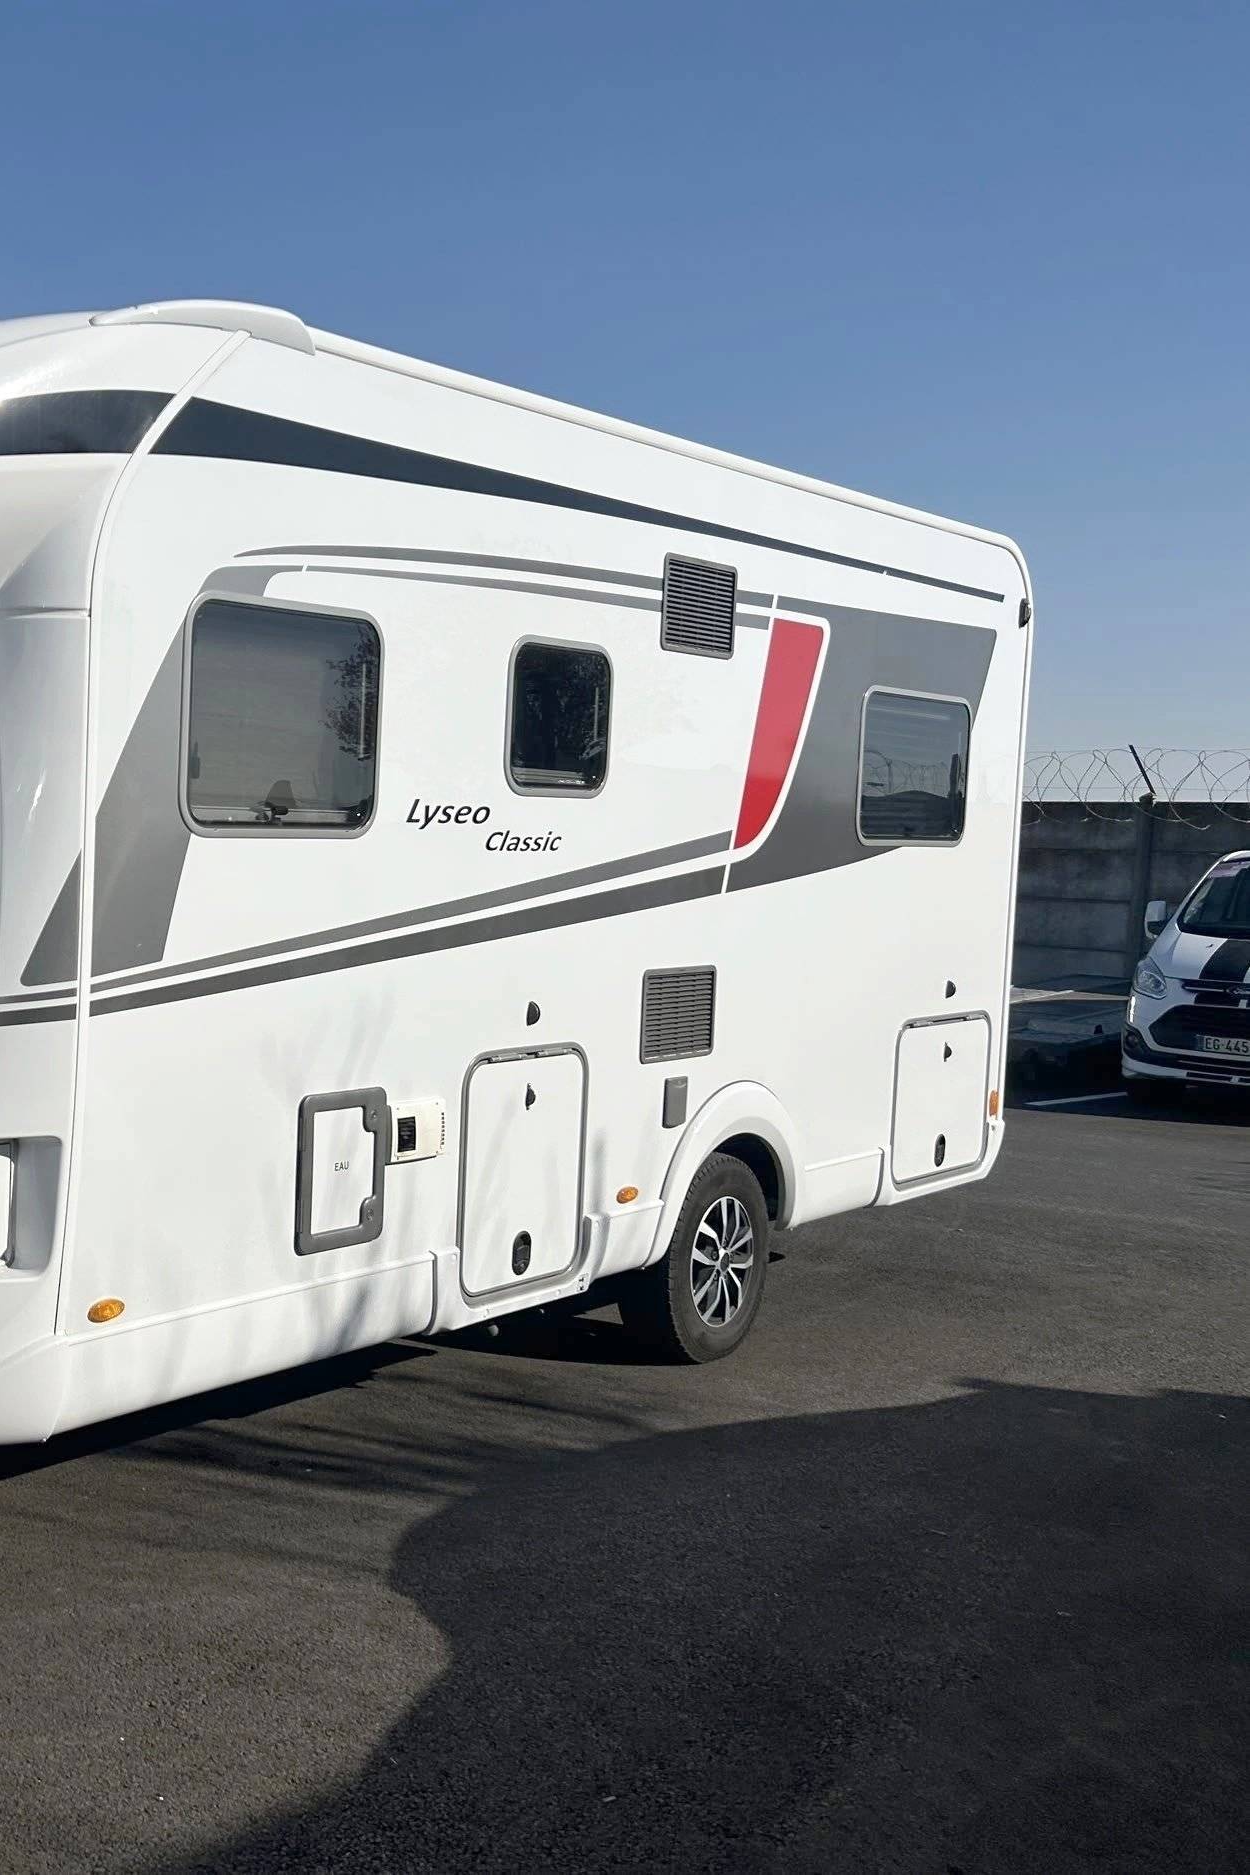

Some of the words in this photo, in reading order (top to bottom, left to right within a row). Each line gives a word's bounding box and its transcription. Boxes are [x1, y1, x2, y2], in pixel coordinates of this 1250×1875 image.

[406, 799, 491, 830] Lyseo
[485, 830, 562, 851] Classic
[334, 1160, 350, 1172] EAU
